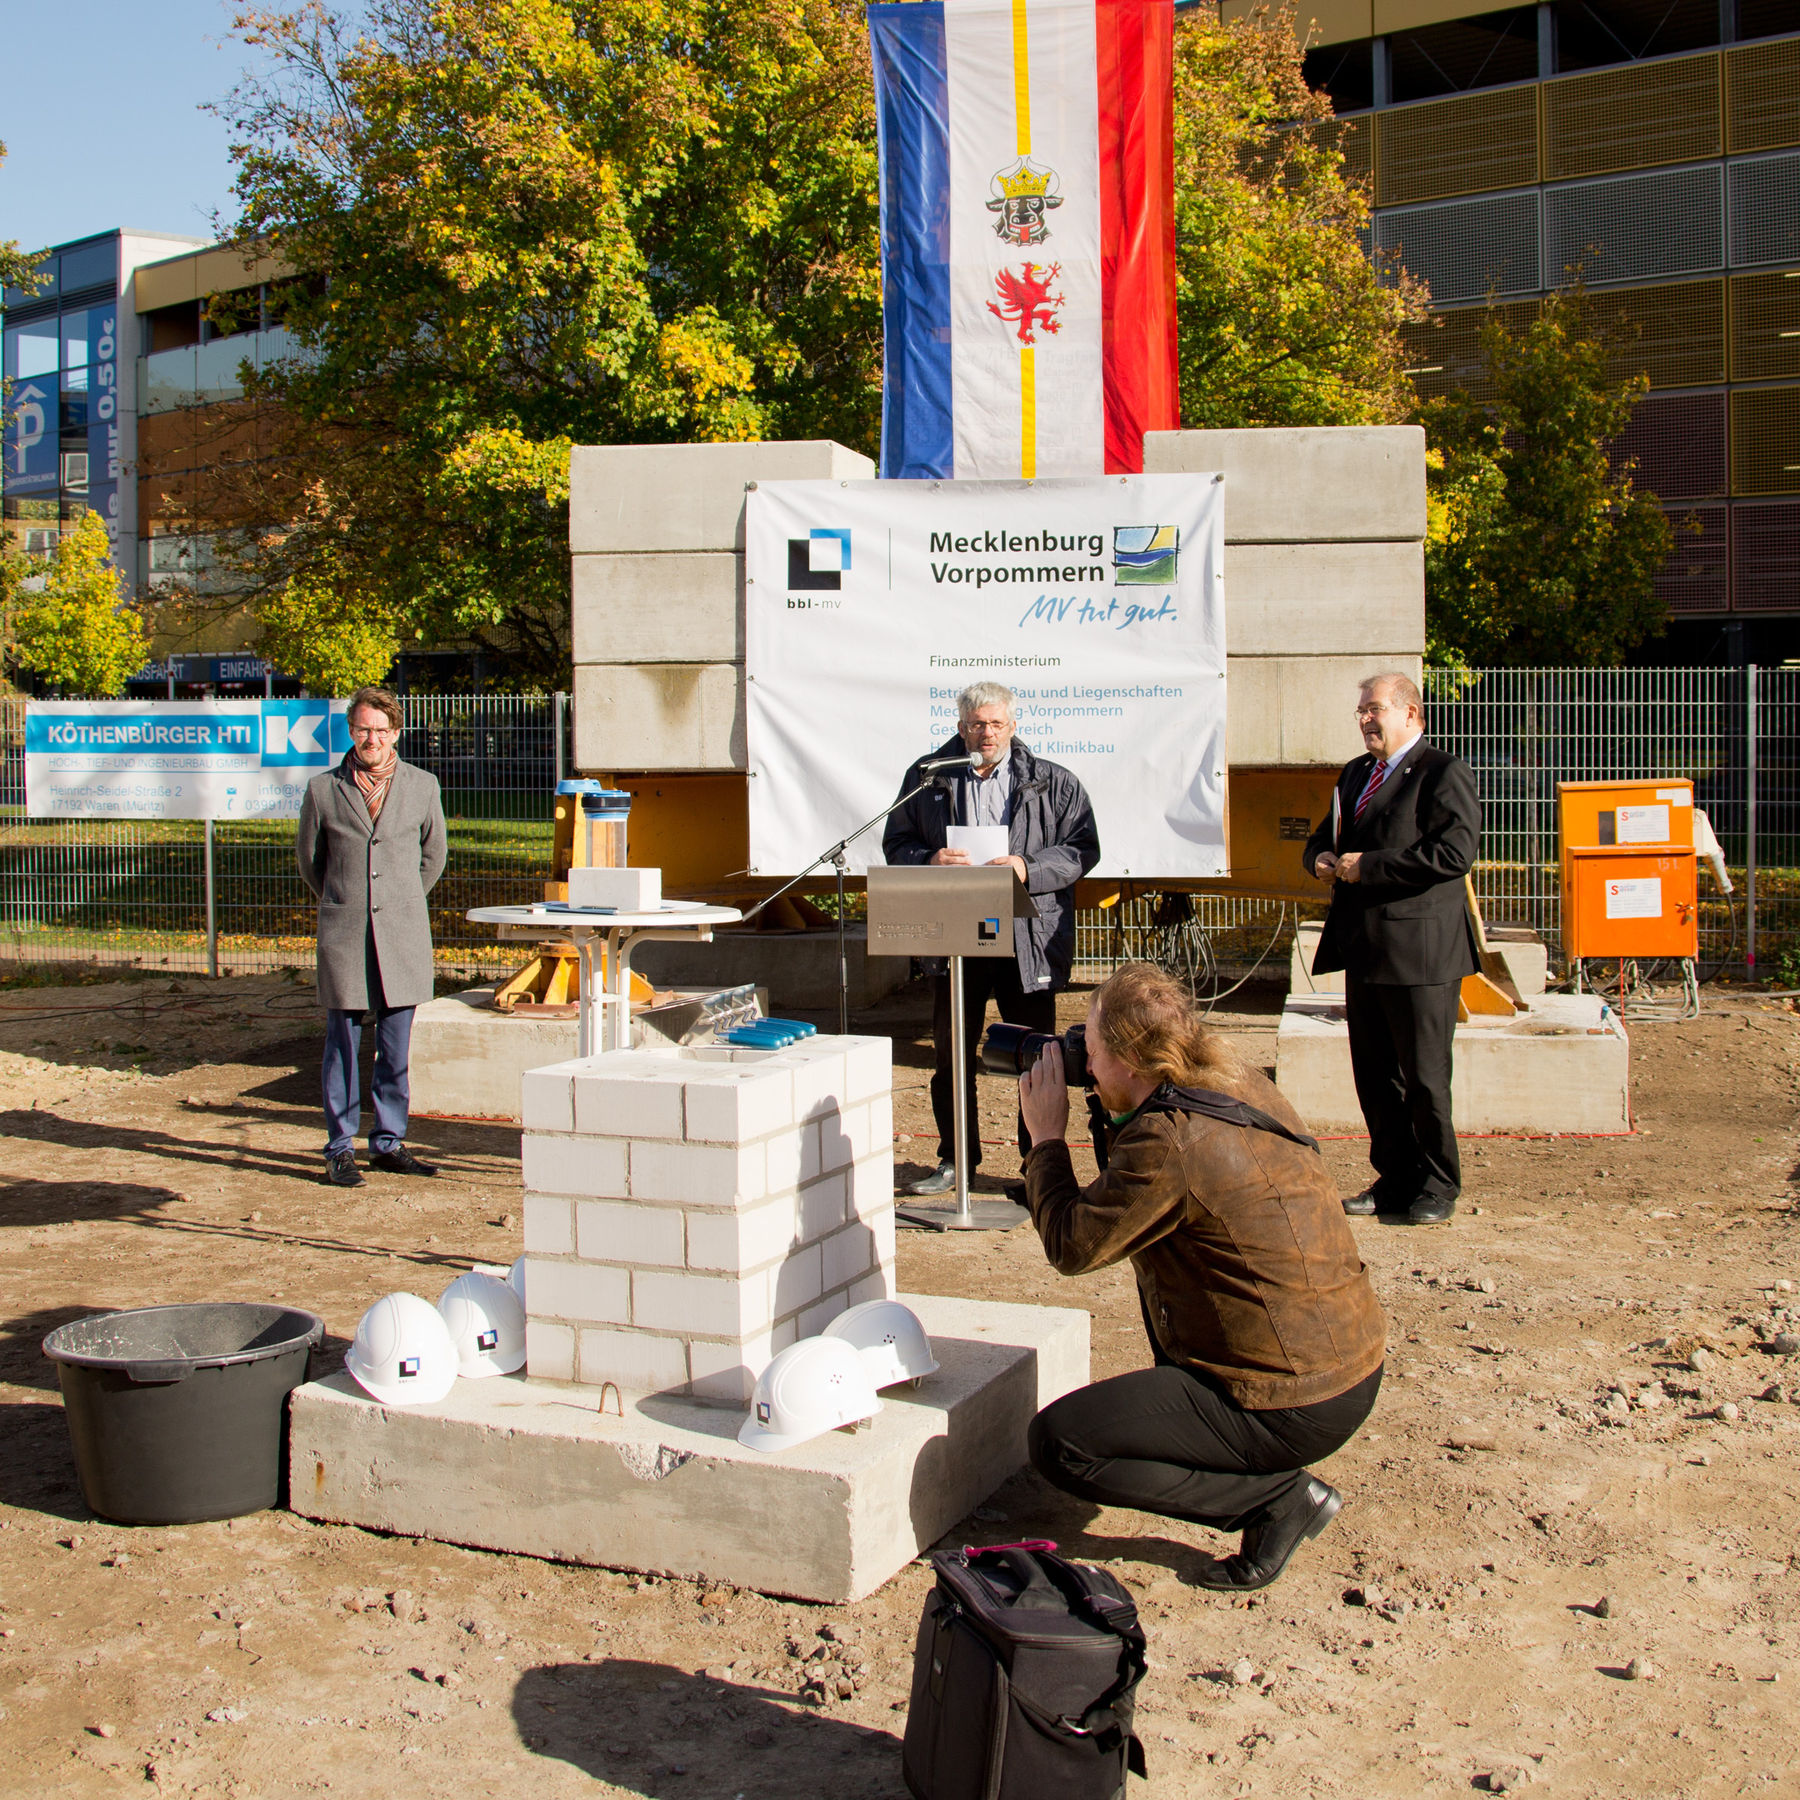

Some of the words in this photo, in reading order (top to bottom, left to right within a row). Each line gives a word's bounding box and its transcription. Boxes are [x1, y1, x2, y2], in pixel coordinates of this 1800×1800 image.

[930, 530, 1104, 557] Mecklenburg
[931, 562, 1105, 588] Vorpommern
[1018, 594, 1077, 628] MV
[1077, 597, 1119, 625] tut
[930, 655, 1061, 667] Finanzministerium
[1041, 686, 1068, 698] und
[1073, 684, 1183, 700] Liegenschaften
[48, 721, 212, 744] KÖTHENBÜRGER
[217, 726, 251, 744] HTI
[1047, 741, 1115, 753] Klinikbau
[138, 758, 213, 768] INGENIEURBAU
[216, 758, 248, 768] GMBH
[49, 784, 172, 797] Heinrich-Seidel-Straße
[175, 785, 183, 797] 2
[51, 799, 82, 811] 17192
[85, 800, 120, 811] Waren
